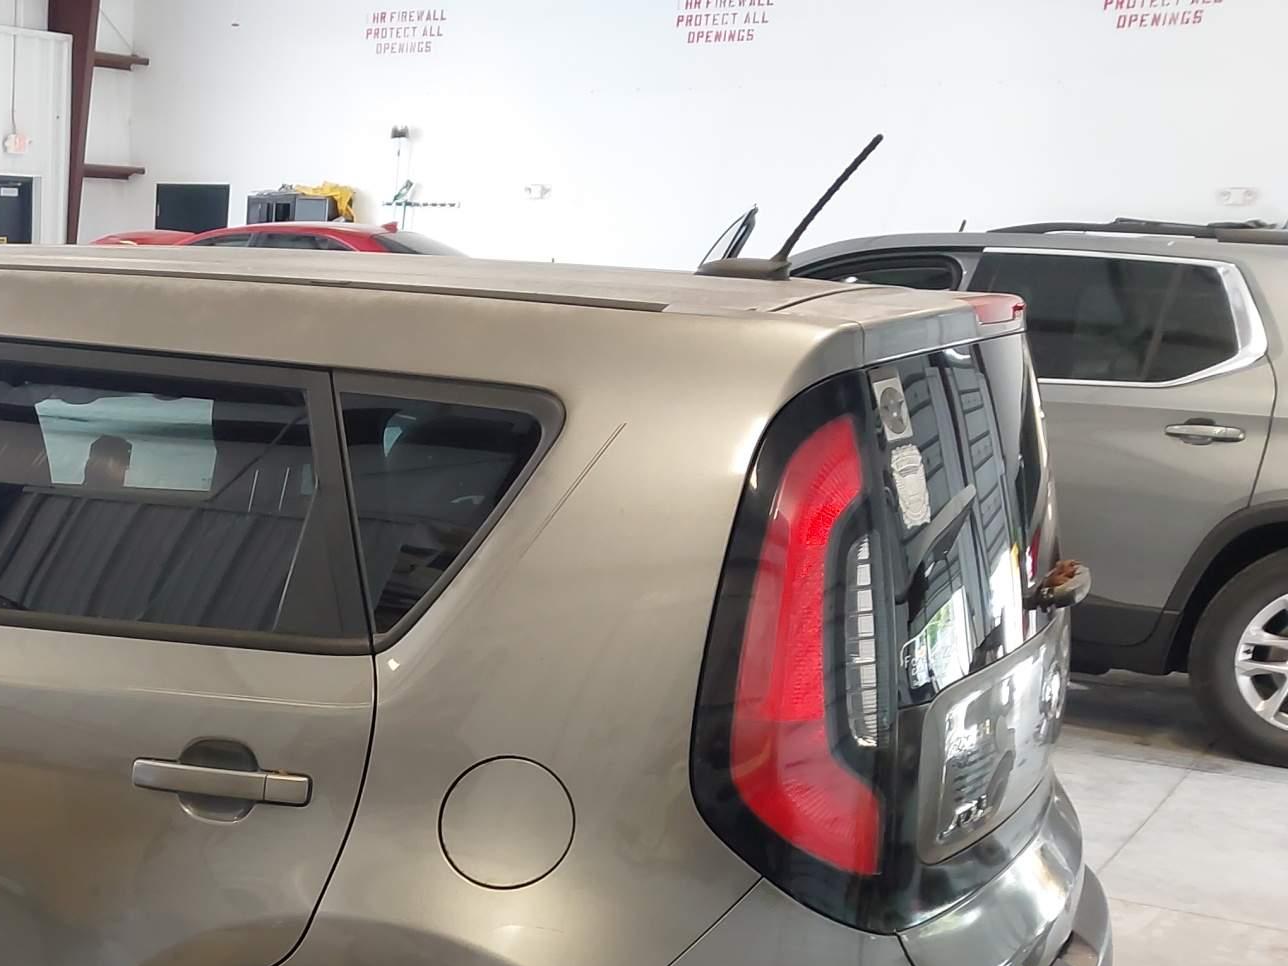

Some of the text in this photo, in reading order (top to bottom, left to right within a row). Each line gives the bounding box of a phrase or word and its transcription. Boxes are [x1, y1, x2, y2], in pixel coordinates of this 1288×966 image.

[372, 11, 387, 24] HR
[389, 9, 447, 23] FIREWALL
[676, 11, 769, 28] PROTECT ALL
[1116, 9, 1204, 29] OPENINGS
[365, 25, 444, 40] PROTECT ALL
[687, 28, 755, 44] OPENINGS
[375, 40, 432, 55] OPENINGS
